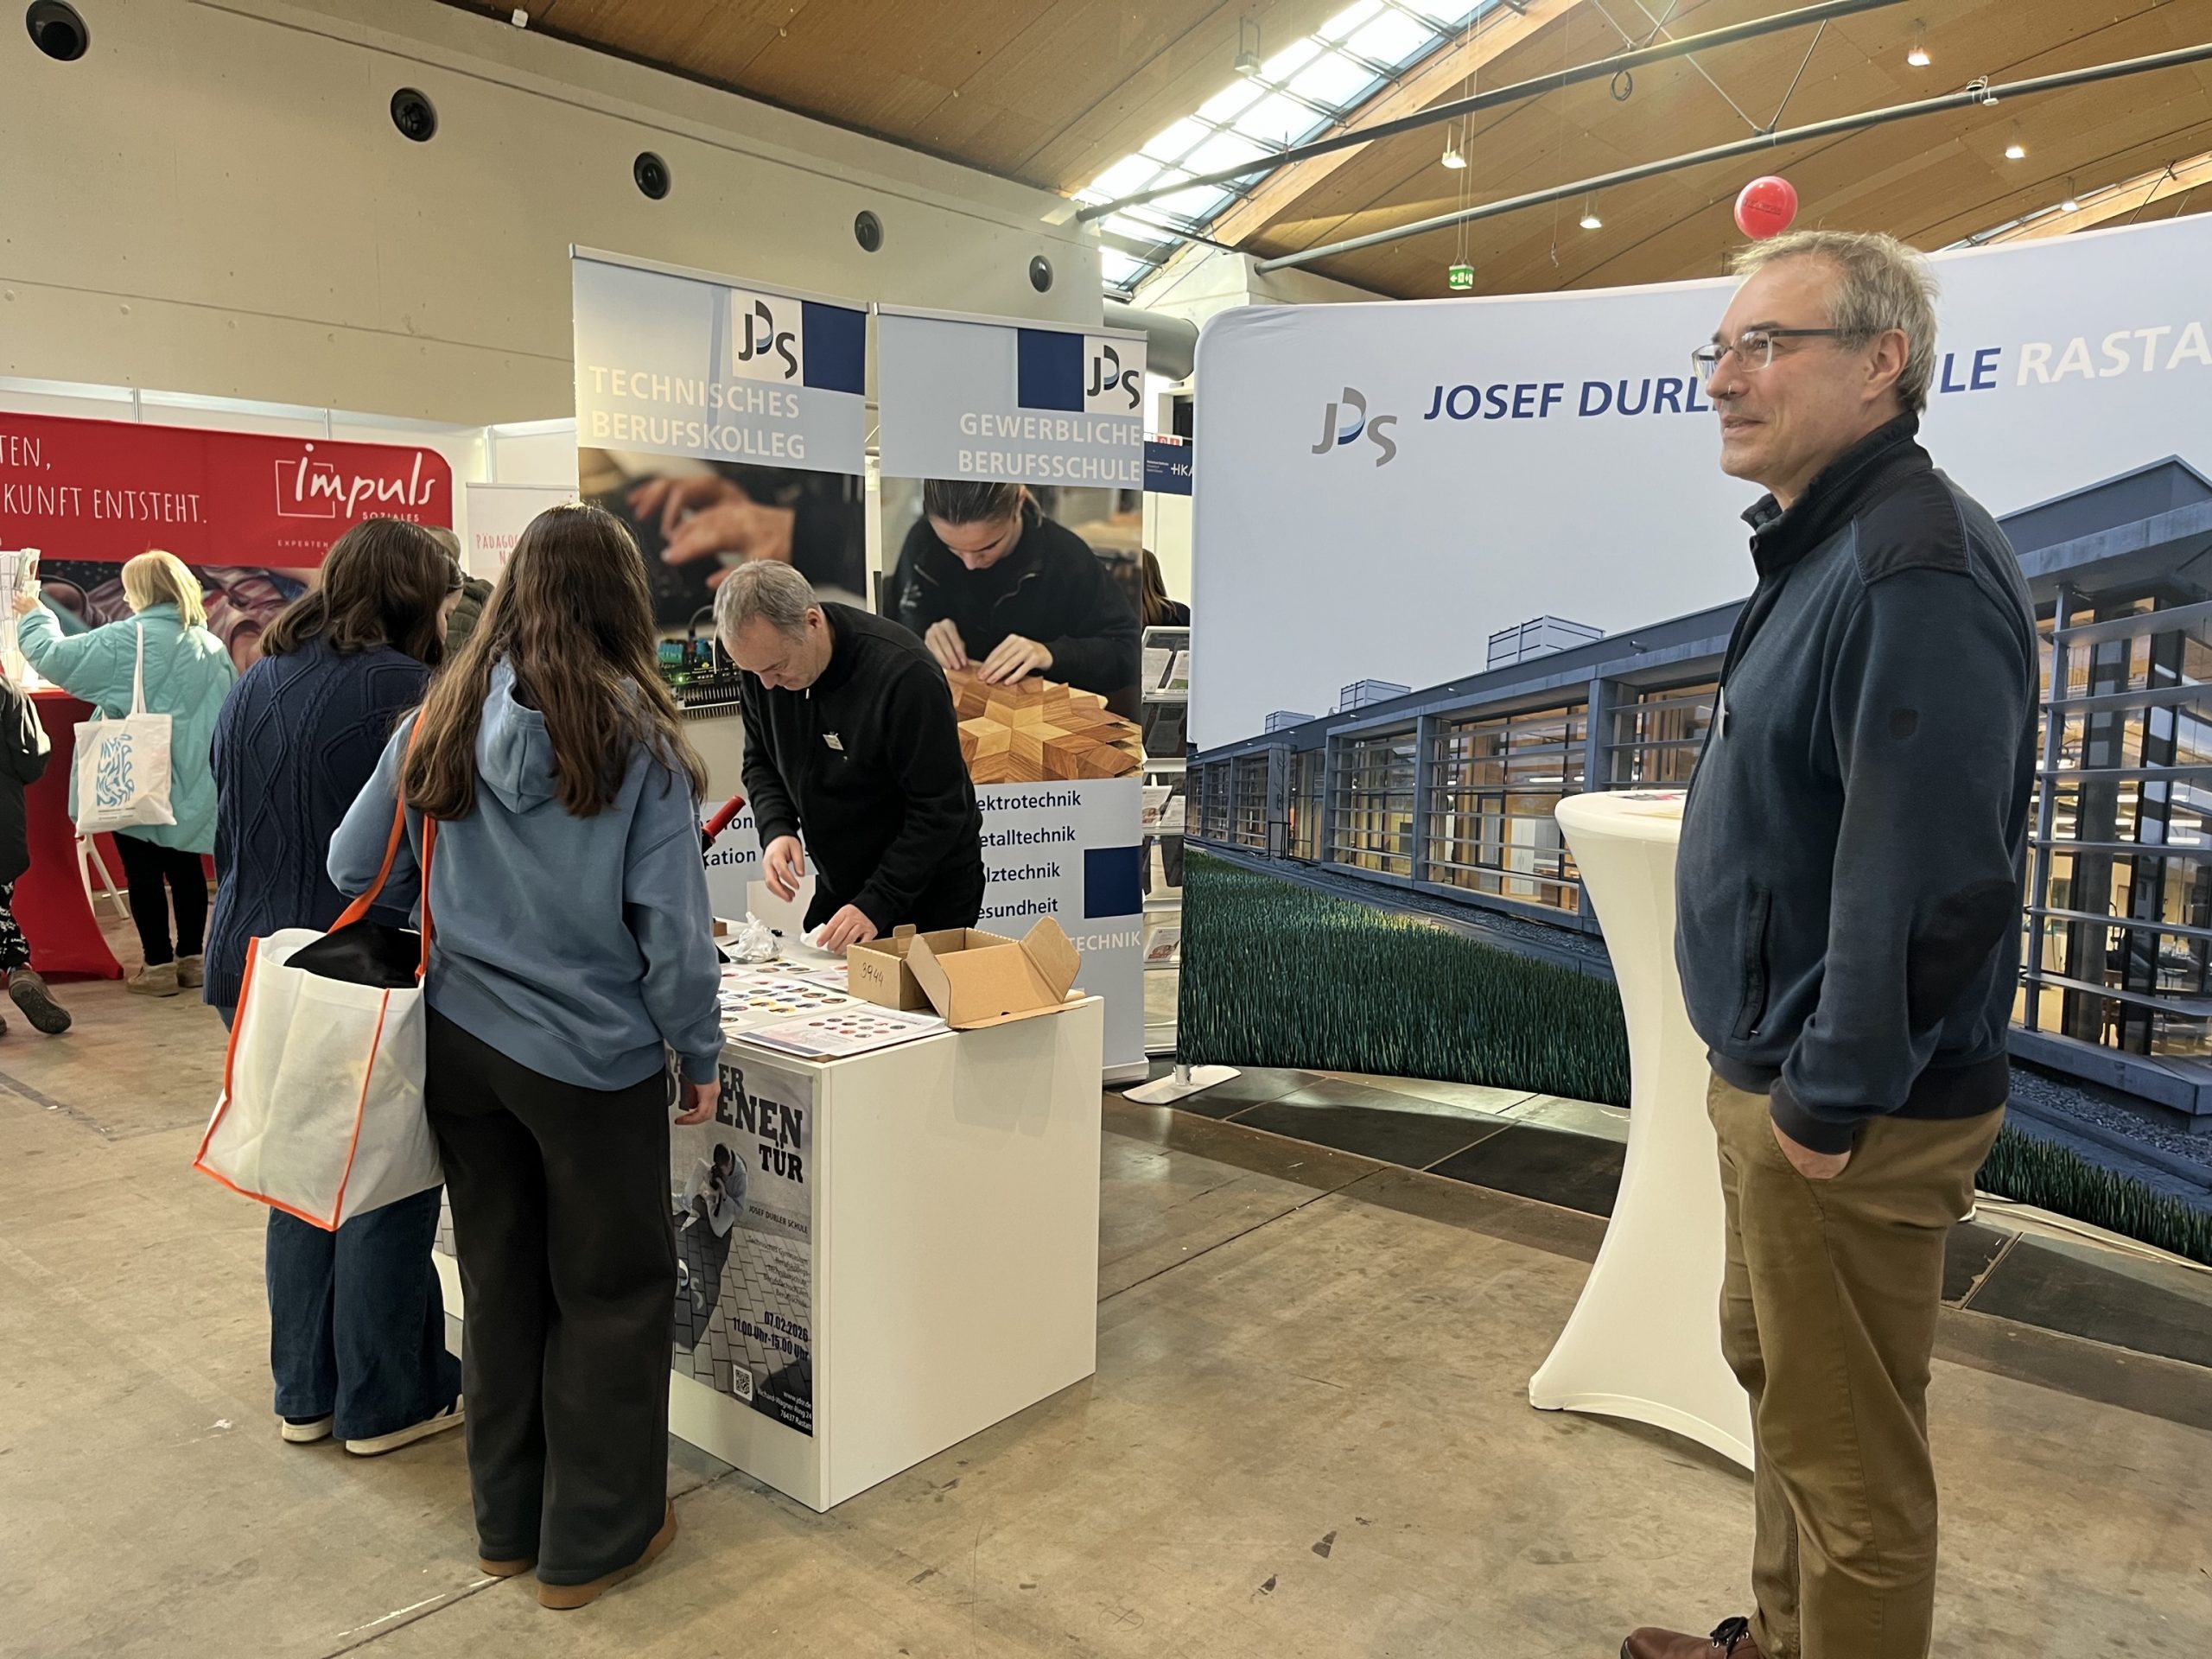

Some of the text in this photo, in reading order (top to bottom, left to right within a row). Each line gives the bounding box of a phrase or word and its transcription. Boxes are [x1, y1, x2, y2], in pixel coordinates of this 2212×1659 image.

[738, 299, 798, 379] JDS
[1087, 345, 1141, 410] JDS
[1423, 321, 2212, 420] JOSEF DURL LE RASTA
[588, 365, 800, 419] TECHNISCHES
[591, 410, 805, 460] BERUFSKOLLEG
[959, 412, 1141, 447] GEWERBLICHE
[1312, 386, 1398, 467] JDS
[0, 435, 52, 471] TEN,
[958, 449, 1141, 482] BERUFSSCHULE
[295, 442, 436, 518] impuls
[3, 483, 208, 524] KUNFT ENTSTEHT.
[277, 539, 329, 549] EXPERTEN
[976, 790, 1081, 811] ektrotechnik
[980, 825, 1076, 848] etalltechnik
[986, 861, 1060, 883] lztechnik
[977, 897, 1058, 919] esundheit
[861, 961, 885, 987] 3944
[718, 1063, 745, 1093] ER
[759, 1141, 804, 1184] TÜR
[748, 1205, 765, 1218] JOSEF
[787, 1218, 808, 1235] SCHULE
[733, 1317, 753, 1337] 11.00
[793, 1344, 810, 1362] Uhr
[764, 1311, 809, 1343] 07.02.2026
